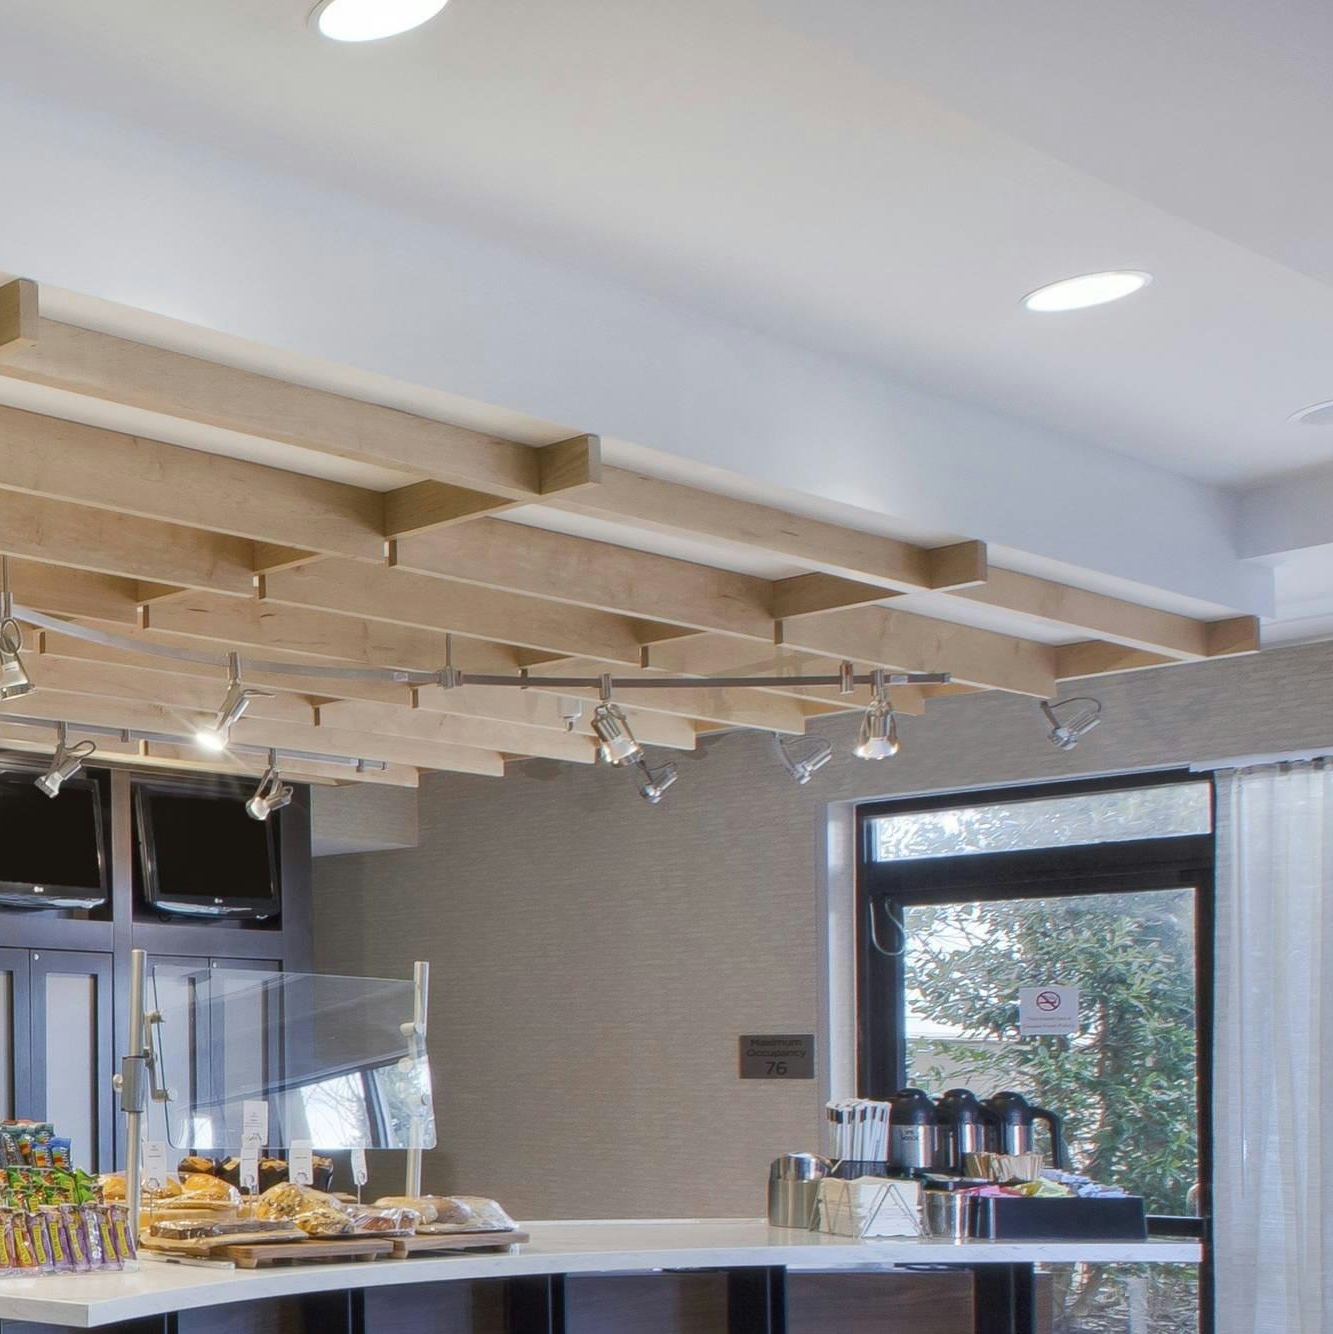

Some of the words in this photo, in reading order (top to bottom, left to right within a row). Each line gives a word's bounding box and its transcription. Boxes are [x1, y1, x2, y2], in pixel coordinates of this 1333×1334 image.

[750, 1038, 803, 1047] Maximum
[745, 1049, 807, 1059] Occupancy
[764, 1061, 788, 1076] 76
